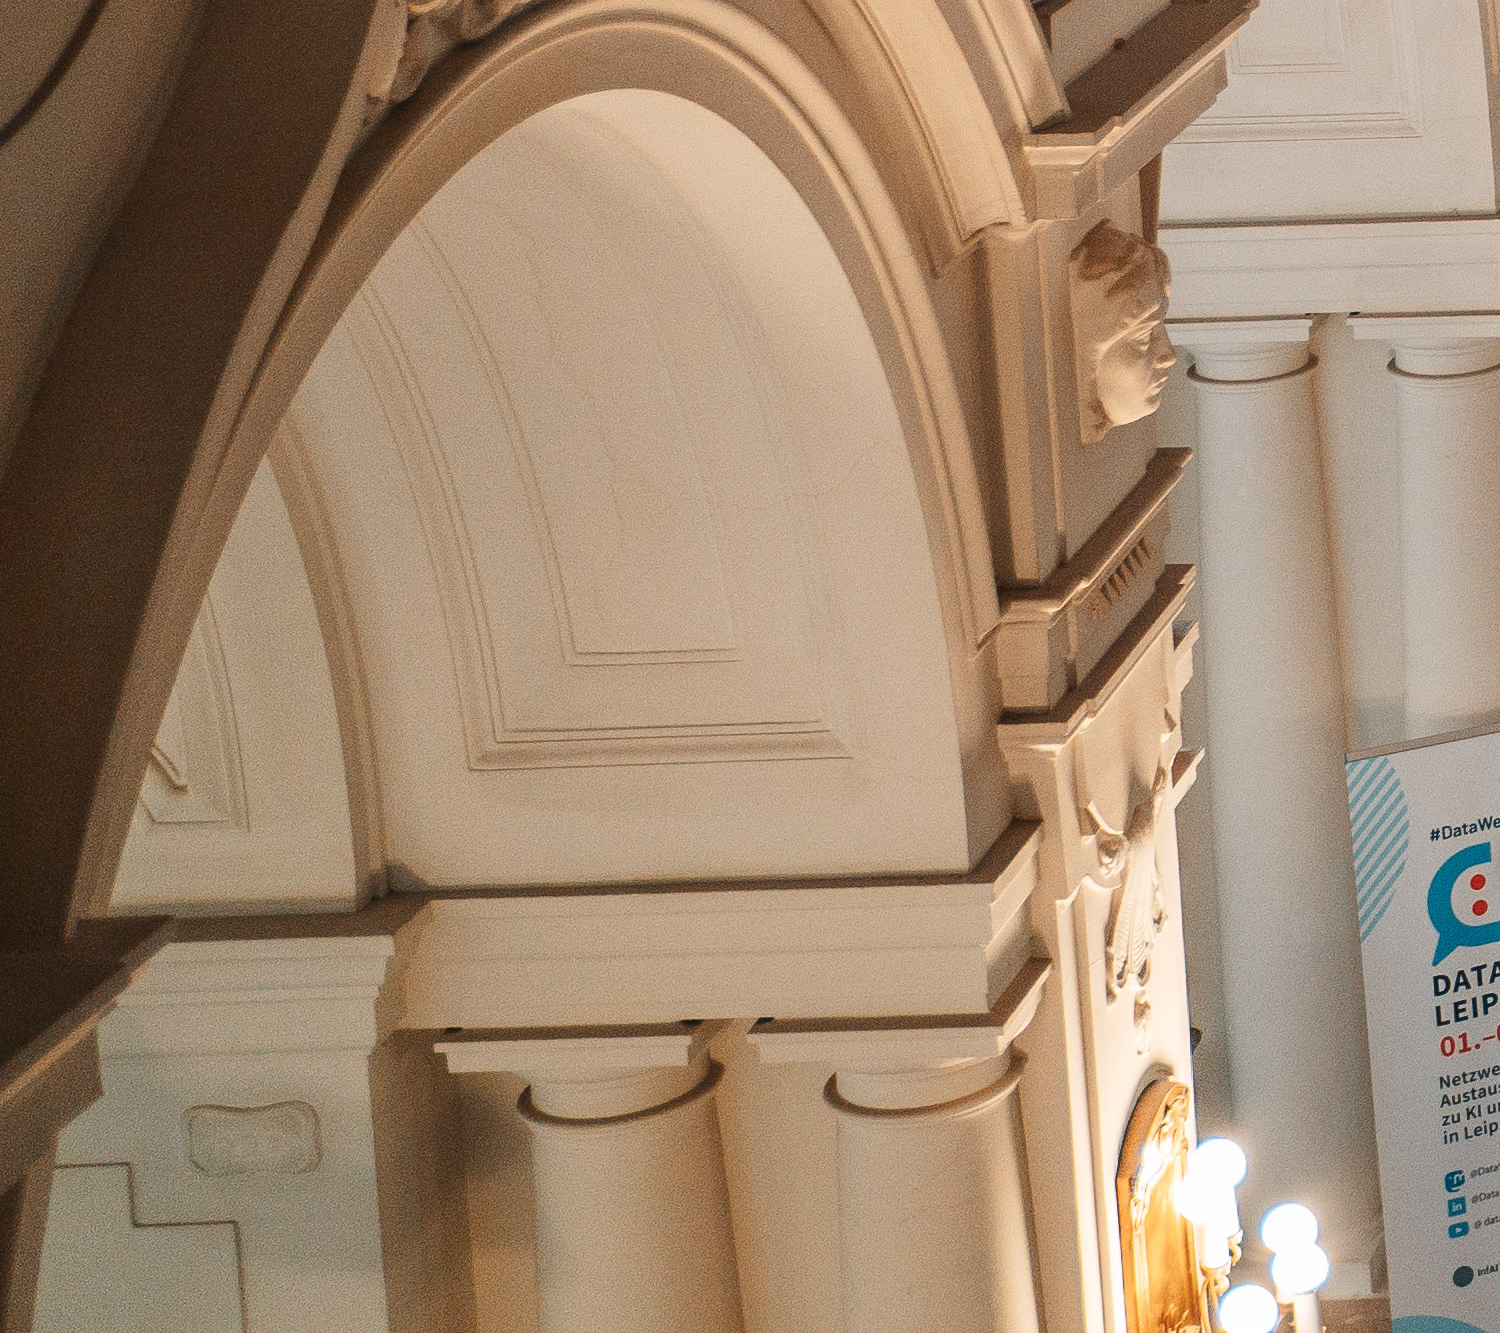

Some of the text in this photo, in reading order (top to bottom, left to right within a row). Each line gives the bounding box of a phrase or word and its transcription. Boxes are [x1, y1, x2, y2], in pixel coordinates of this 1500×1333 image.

[1442, 1112, 1460, 1127] zu
[1466, 1105, 1482, 1121] KI
[1443, 1131, 1458, 1145] in
